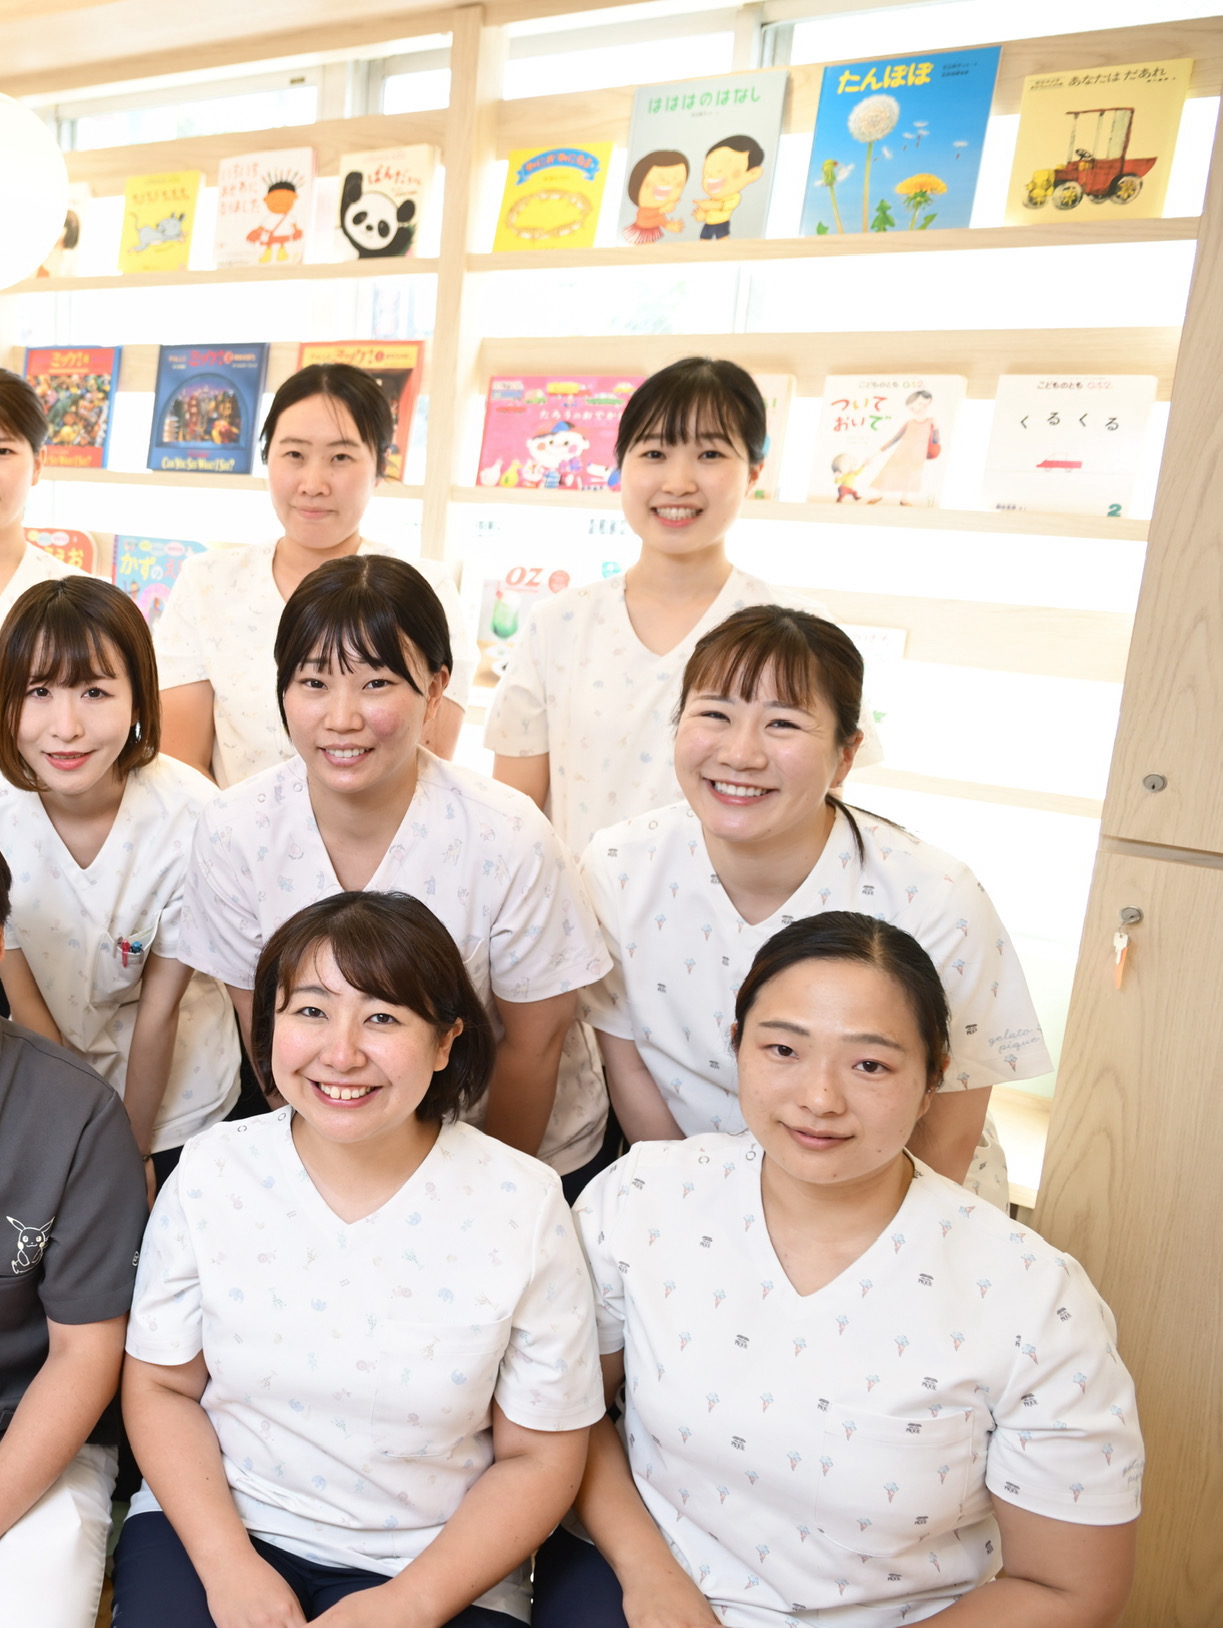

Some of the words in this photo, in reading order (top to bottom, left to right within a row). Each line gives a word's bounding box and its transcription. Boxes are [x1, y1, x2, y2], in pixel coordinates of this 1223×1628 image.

[837, 62, 934, 94] たんぽぽ
[648, 86, 761, 114] はははのはなし
[831, 396, 888, 412] ついて
[539, 409, 622, 421] たろうのおでか
[834, 415, 892, 432] おいで
[1107, 504, 1122, 517] 2
[988, 1029, 1031, 1047] gelato
[998, 1038, 1040, 1054] pique
